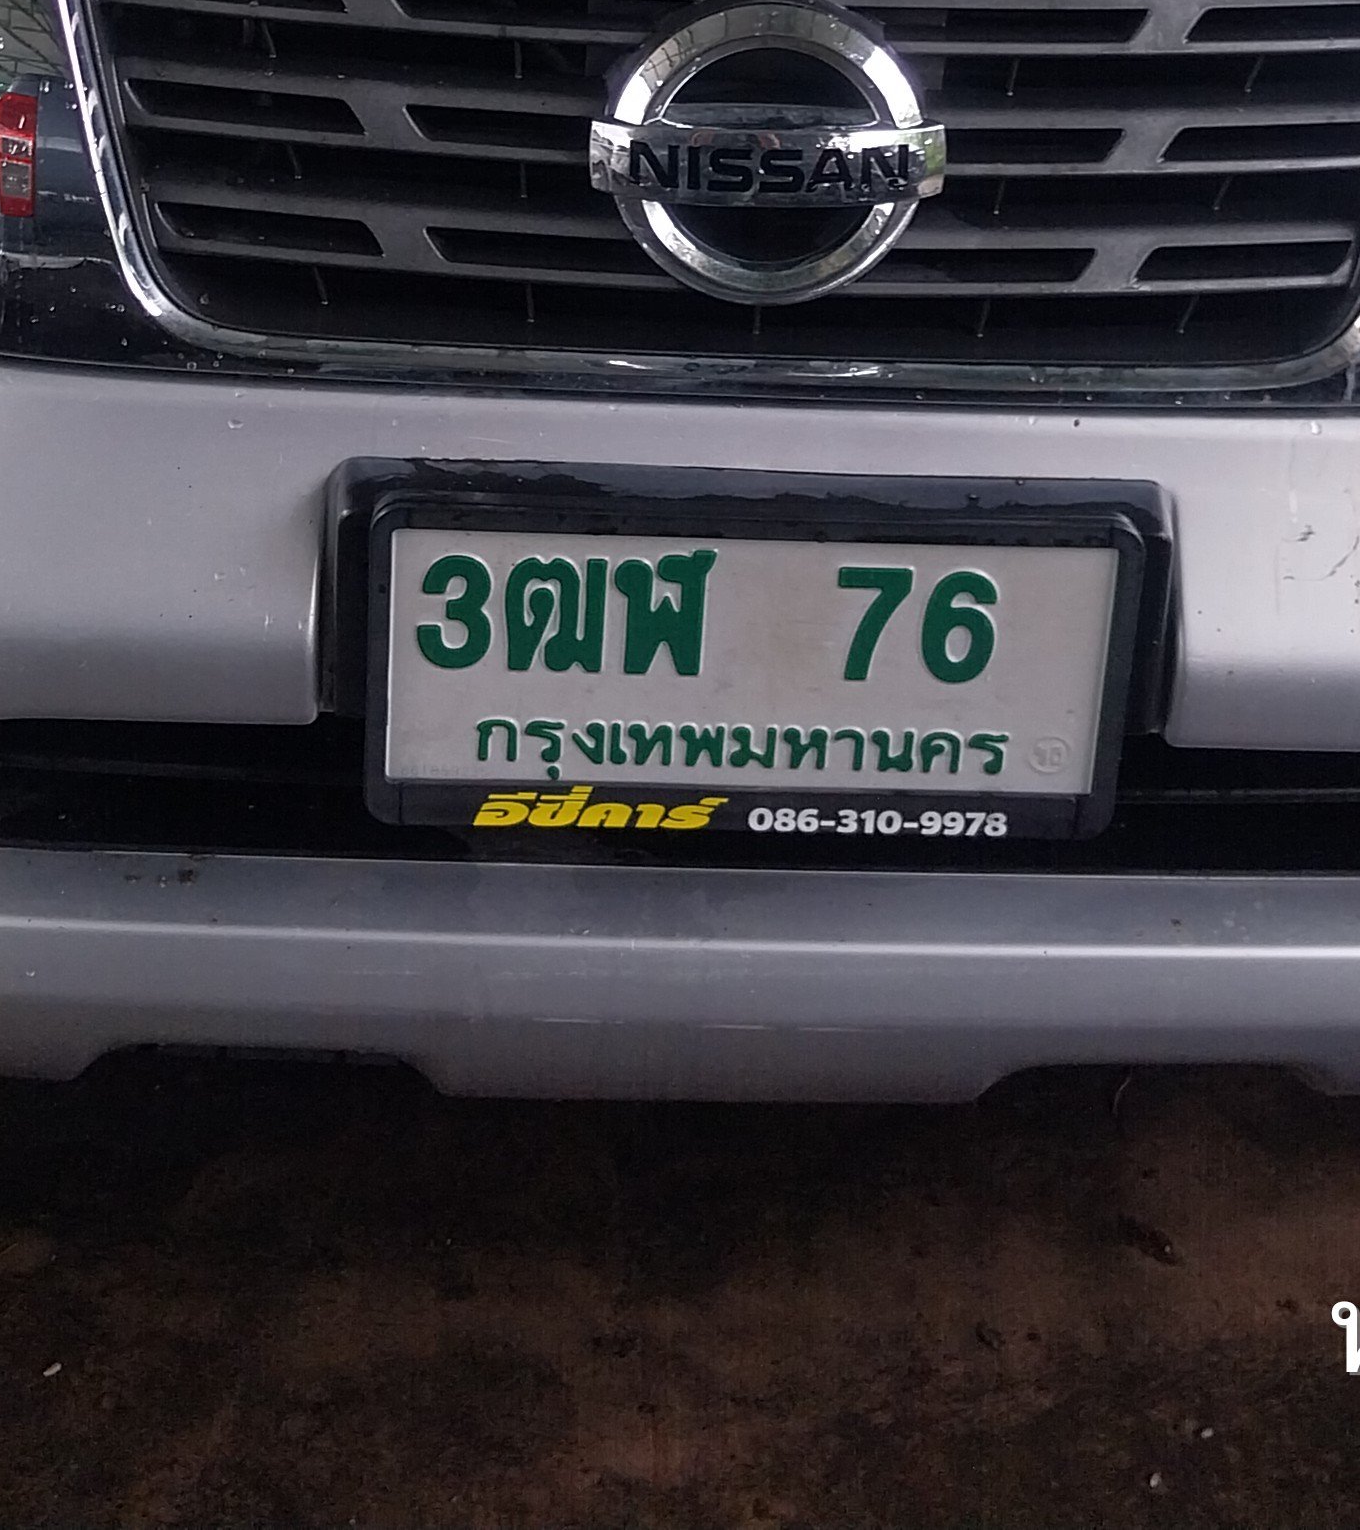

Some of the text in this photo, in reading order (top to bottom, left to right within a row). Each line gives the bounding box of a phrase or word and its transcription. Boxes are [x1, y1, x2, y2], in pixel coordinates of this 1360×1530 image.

[628, 139, 910, 194] NISSAN
[415, 548, 998, 684] 3ฒฬ 76
[475, 717, 1010, 781] กรุงเทพมหานคร
[747, 806, 1009, 839] 086-310-9978
